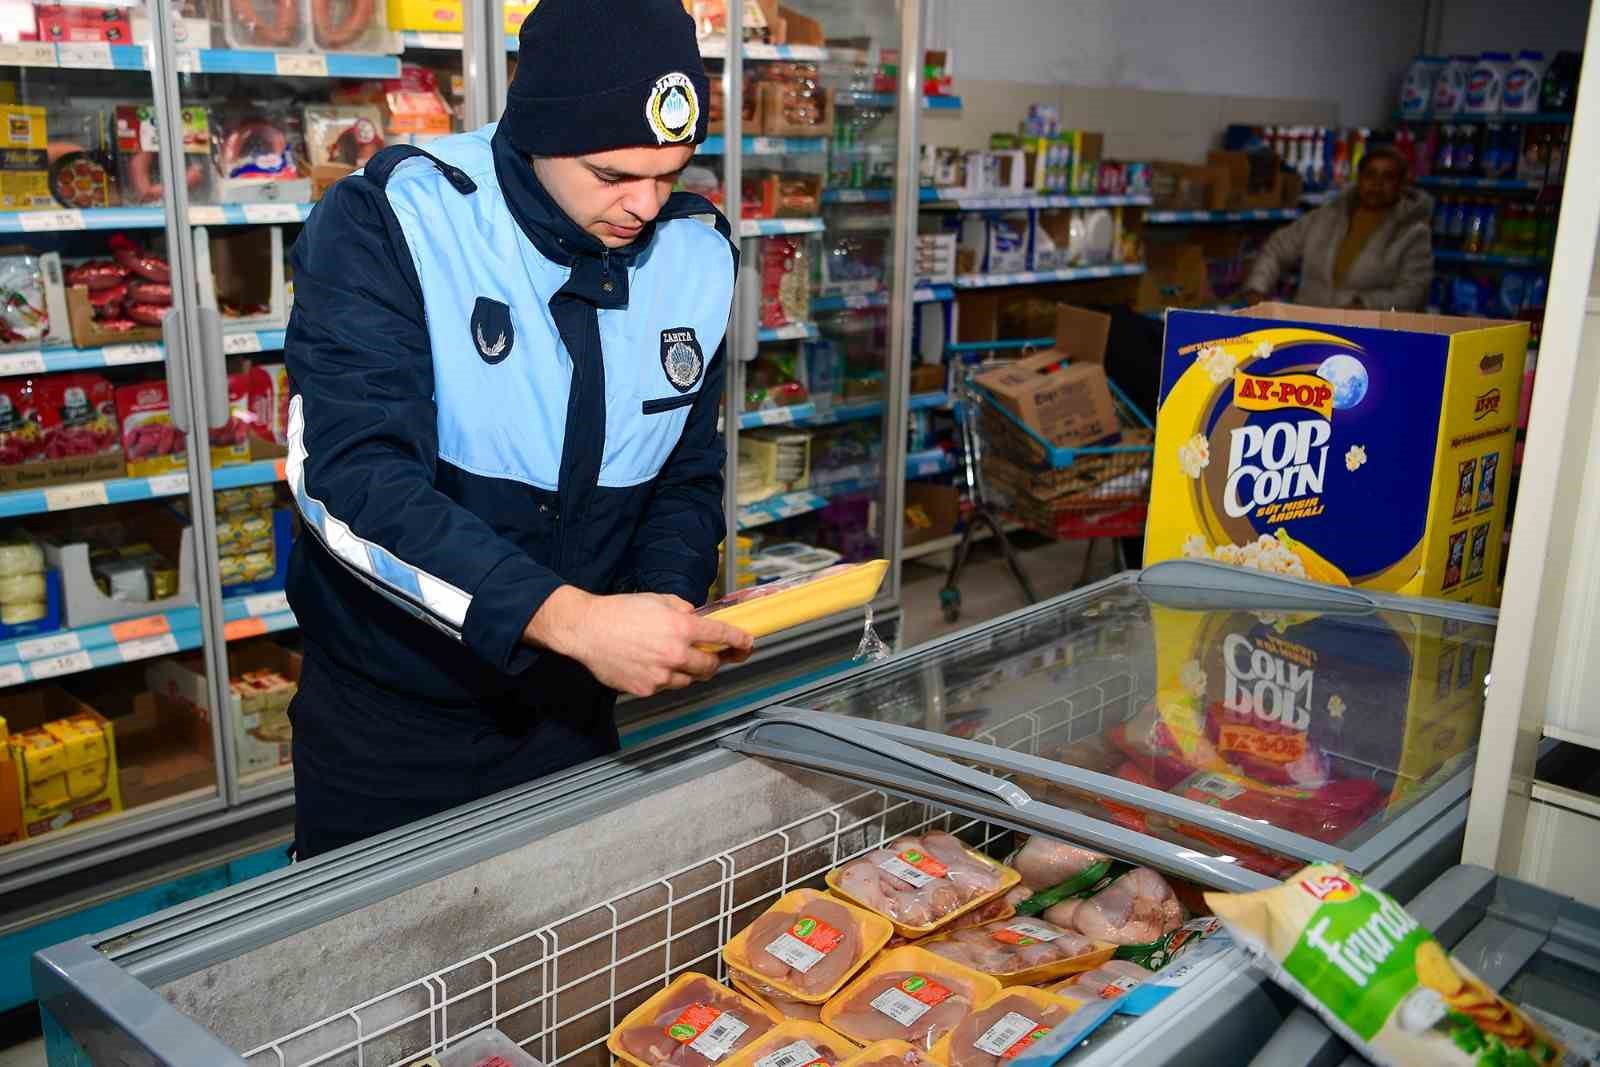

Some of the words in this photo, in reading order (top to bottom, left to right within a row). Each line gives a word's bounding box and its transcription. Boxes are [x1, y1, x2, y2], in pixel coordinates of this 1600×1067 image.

[663, 331, 693, 343] ZABITA
[1238, 378, 1332, 408] AY-POP
[1228, 419, 1331, 477] POP
